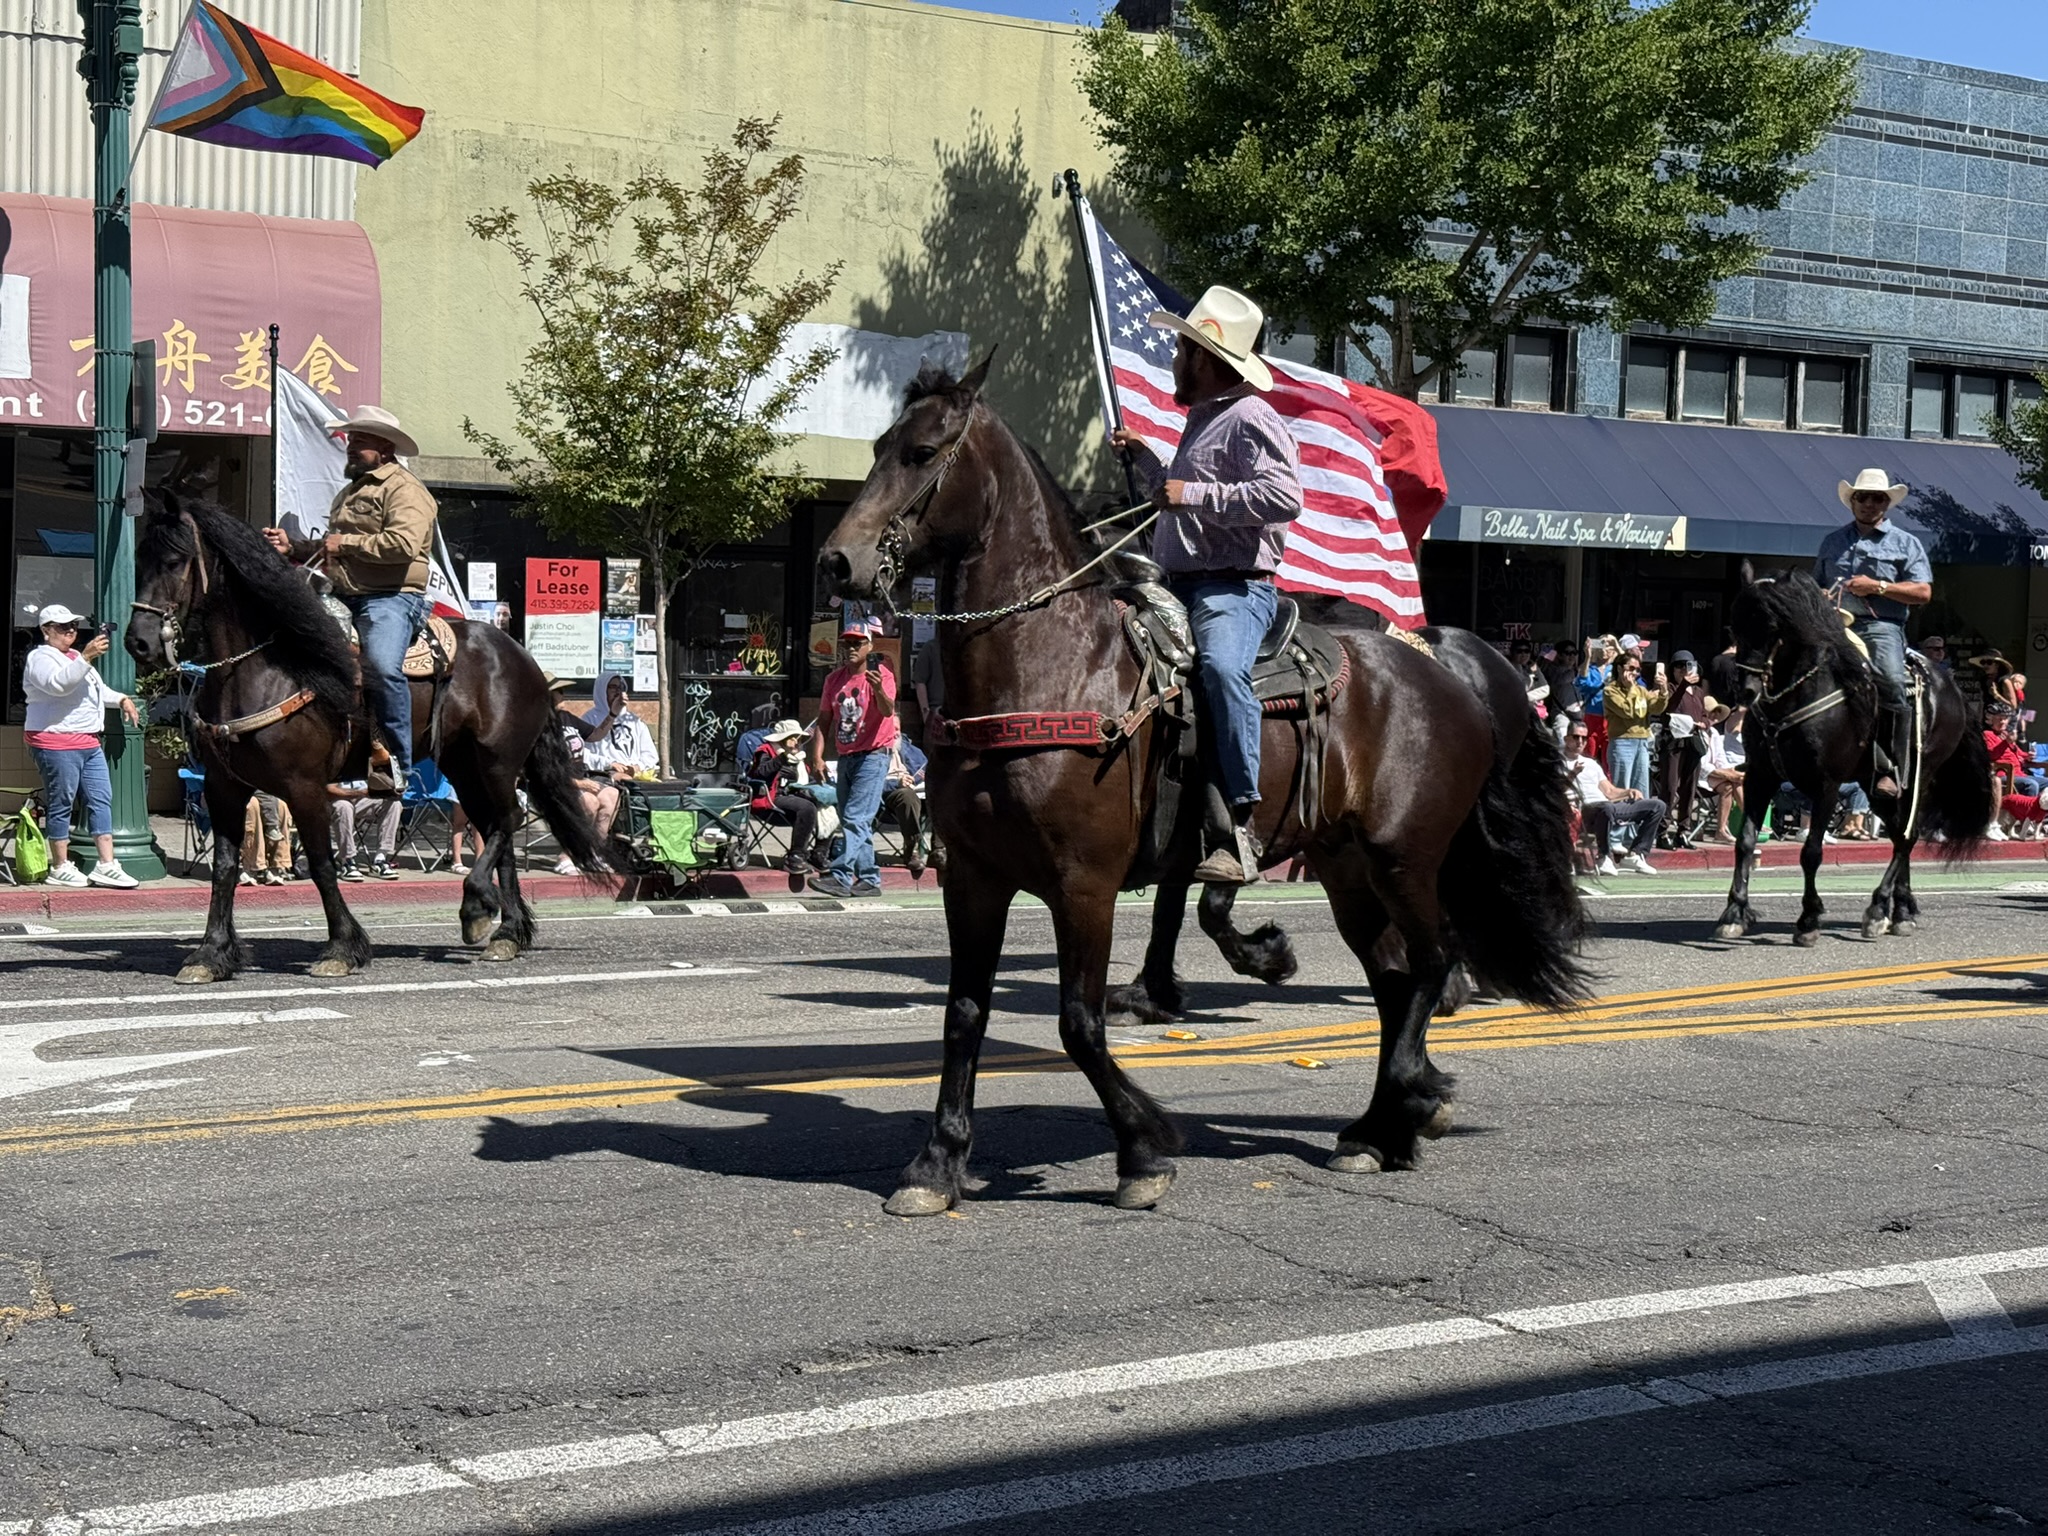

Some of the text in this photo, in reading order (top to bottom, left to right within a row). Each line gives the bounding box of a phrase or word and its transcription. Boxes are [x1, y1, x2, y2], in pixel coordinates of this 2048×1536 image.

[0, 392, 43, 417] nt
[1485, 510, 1664, 549] Bella Nail Spa & Waxing
[548, 562, 579, 577] For
[537, 579, 589, 595] Lease
[530, 599, 596, 610] 415.395.7262
[530, 622, 575, 630] Justin Choi
[1502, 622, 1531, 640] TK
